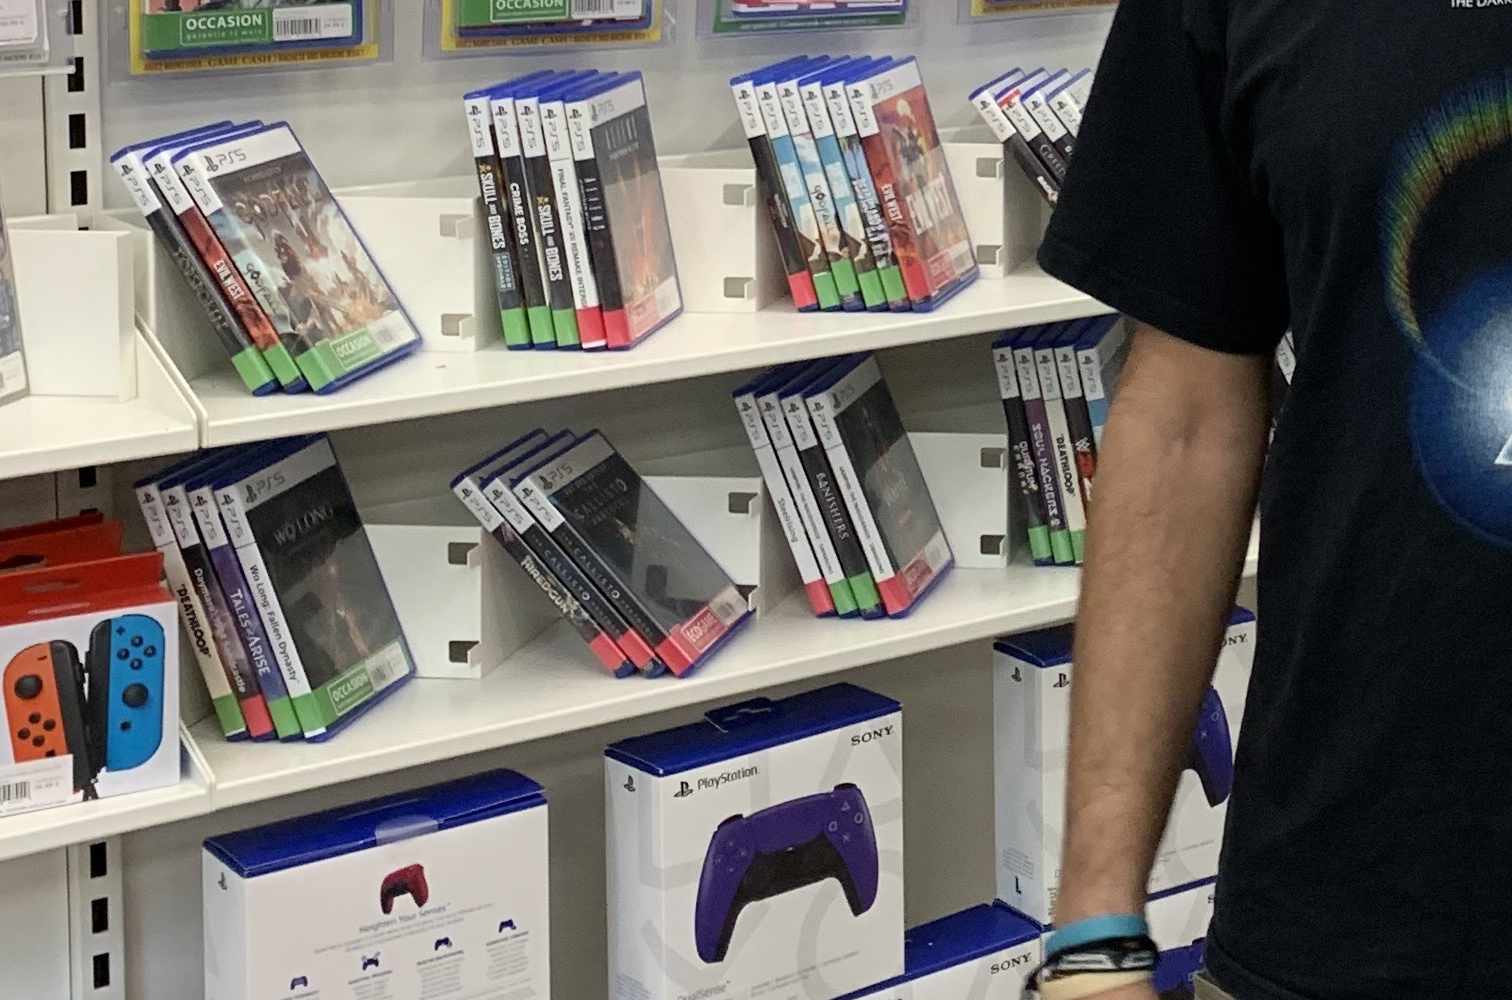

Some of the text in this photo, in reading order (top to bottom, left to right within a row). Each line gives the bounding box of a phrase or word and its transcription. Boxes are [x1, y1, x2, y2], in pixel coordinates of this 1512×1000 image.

[186, 14, 263, 31] OCCASION
[217, 149, 247, 168] PS5
[480, 171, 506, 250] SKULL BONES
[509, 183, 530, 246] CRIME BOSS
[537, 203, 563, 282] SKULL BONES
[213, 259, 246, 301] EVIL WEST
[816, 472, 850, 540] BANISHERS
[544, 549, 591, 601] CALLISTO
[574, 547, 621, 599] CALLISTO
[250, 564, 261, 581] Wo
[267, 611, 282, 641] Fallen
[230, 588, 271, 676] TALES ARISE
[332, 674, 369, 702] OCCASION
[850, 725, 895, 747] SONY
[697, 764, 758, 790] PlayStation
[991, 952, 1033, 976] SONY
